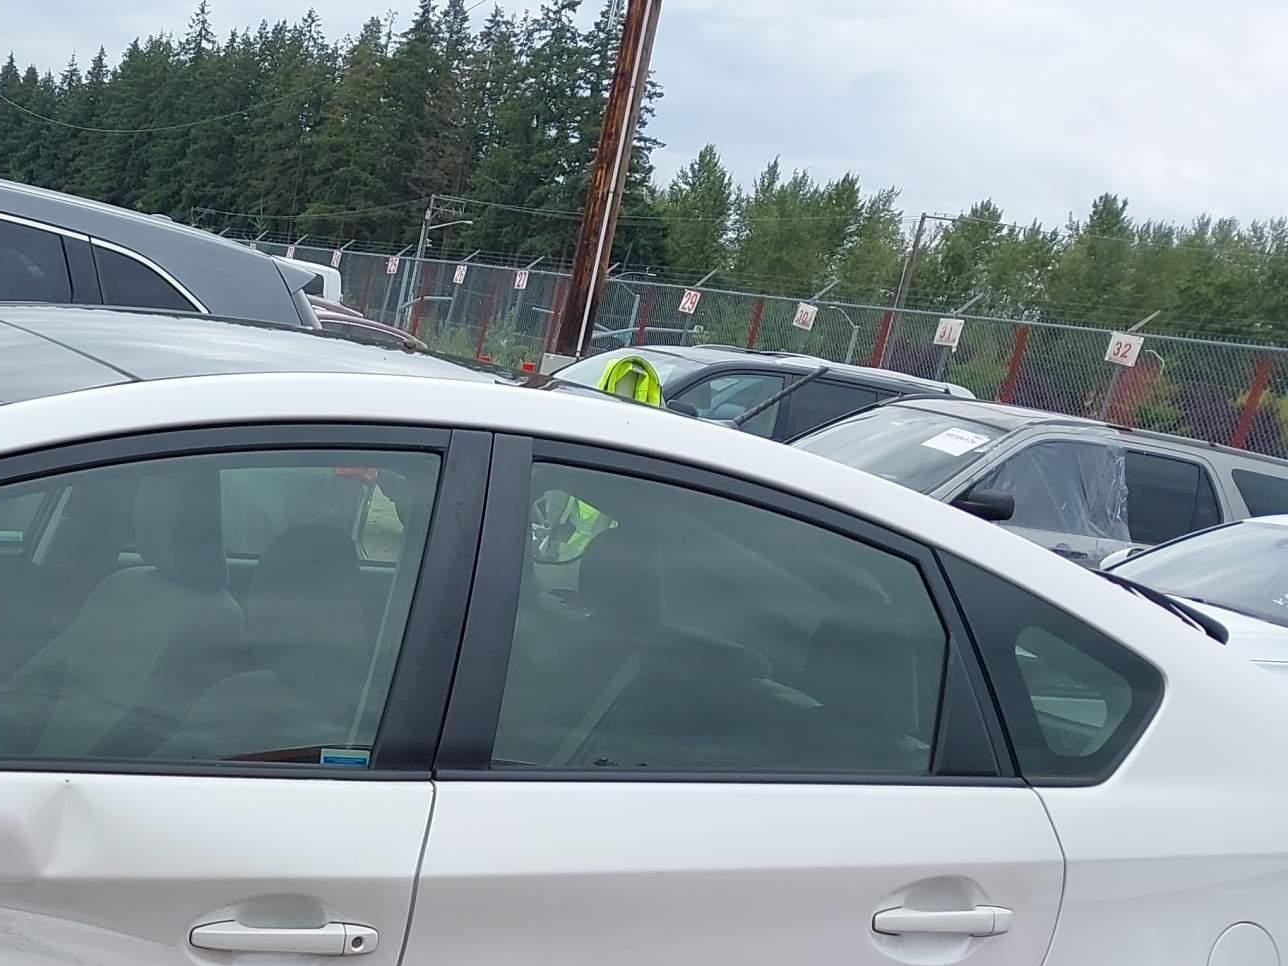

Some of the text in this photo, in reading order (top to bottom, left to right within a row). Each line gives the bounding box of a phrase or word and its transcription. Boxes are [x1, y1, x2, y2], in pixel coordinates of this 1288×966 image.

[682, 292, 697, 311] 29
[797, 310, 809, 323] 30
[939, 326, 952, 340] 31
[1112, 341, 1132, 359] 32
